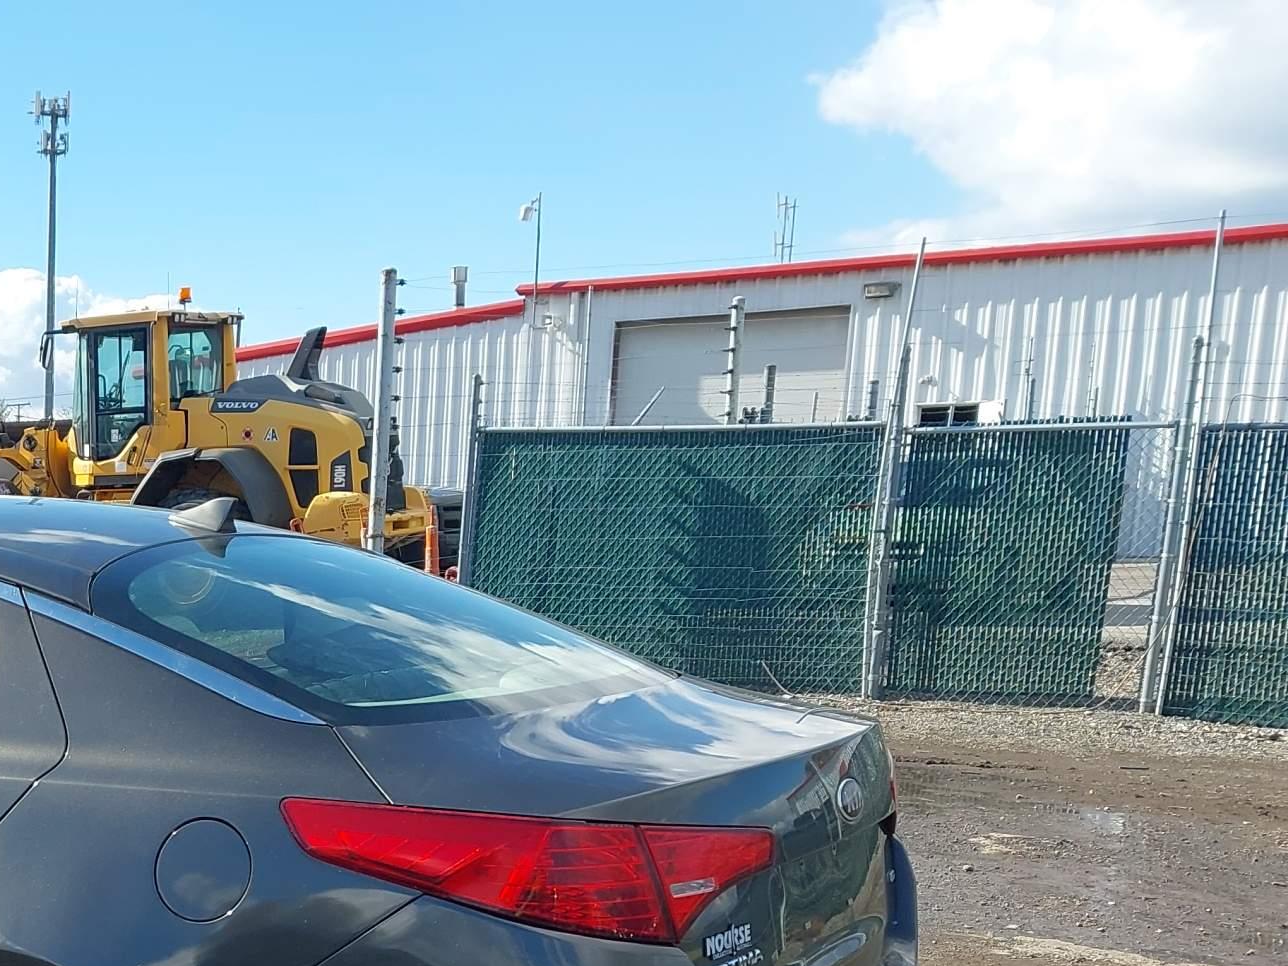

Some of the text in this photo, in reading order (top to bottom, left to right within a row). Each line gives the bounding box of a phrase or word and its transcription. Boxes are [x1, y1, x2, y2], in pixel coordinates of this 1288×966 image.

[216, 401, 259, 409] VOLVO
[334, 464, 347, 488] L90H
[706, 923, 752, 957] NOURSE
